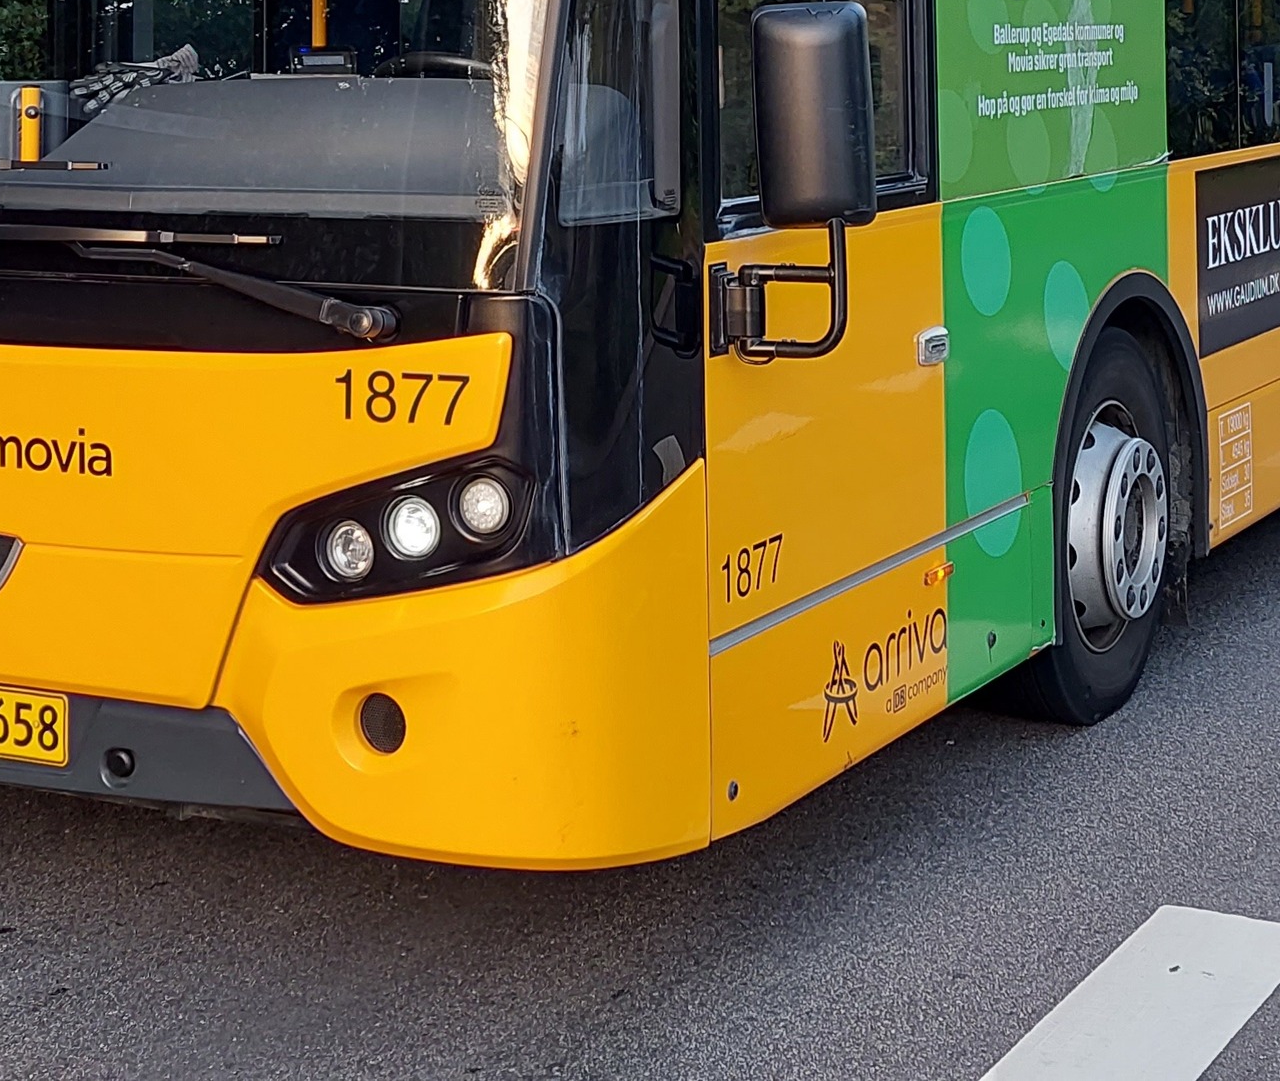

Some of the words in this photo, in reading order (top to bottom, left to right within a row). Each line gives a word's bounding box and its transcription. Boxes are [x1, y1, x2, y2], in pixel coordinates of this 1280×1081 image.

[993, 23, 1030, 47] Ballerup
[1031, 26, 1042, 47] og
[1042, 22, 1074, 47] Egedals
[1114, 24, 1124, 43] og
[1008, 49, 1033, 73] Movia
[1034, 48, 1058, 70] sikrer
[1077, 47, 1113, 70] transport
[978, 94, 996, 119] Hop
[997, 90, 1008, 119] på
[1009, 95, 1020, 117] og
[1036, 93, 1047, 110] en
[1047, 86, 1076, 109] forskel
[1088, 82, 1110, 106] klima
[1110, 86, 1120, 105] og
[1206, 273, 1280, 317] WWW.GAUDIUM.DK
[334, 366, 470, 427] 1877
[720, 533, 784, 604] 1877
[863, 609, 947, 692] arriva
[894, 688, 905, 709] DB
[907, 665, 947, 700] company
